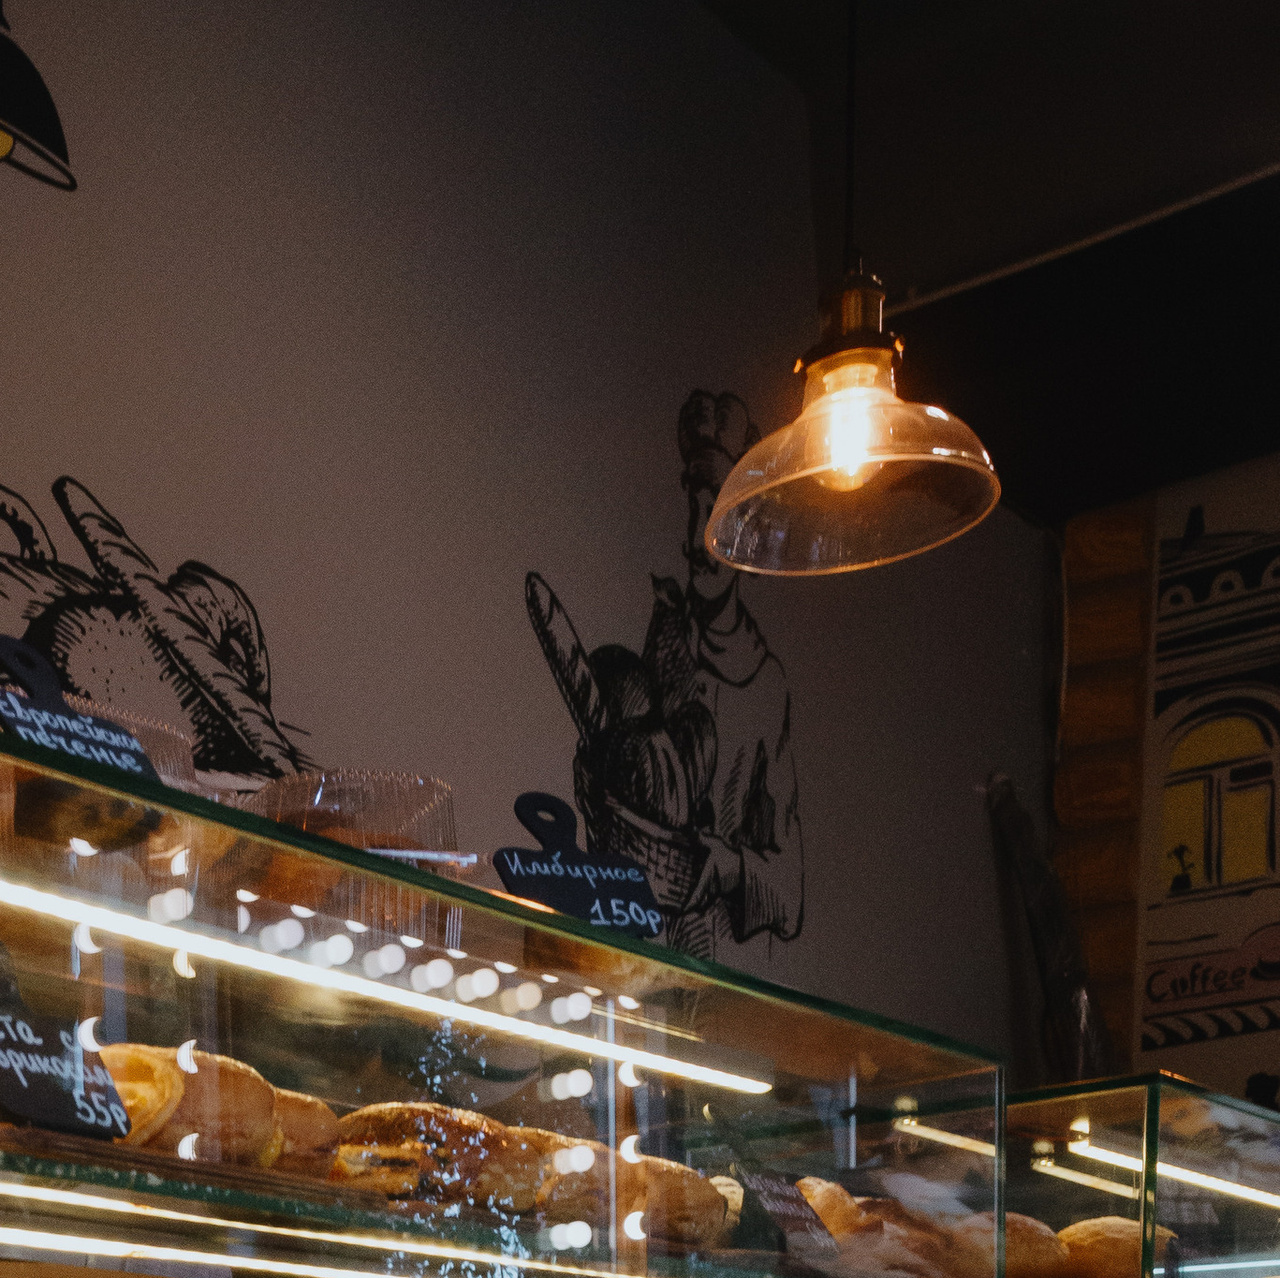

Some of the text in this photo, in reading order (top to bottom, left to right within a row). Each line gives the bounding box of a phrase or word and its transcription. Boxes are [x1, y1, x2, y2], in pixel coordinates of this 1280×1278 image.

[589, 898, 662, 934] 150р
[1146, 961, 1248, 1004] Coffee
[73, 1089, 128, 1136] 55р
